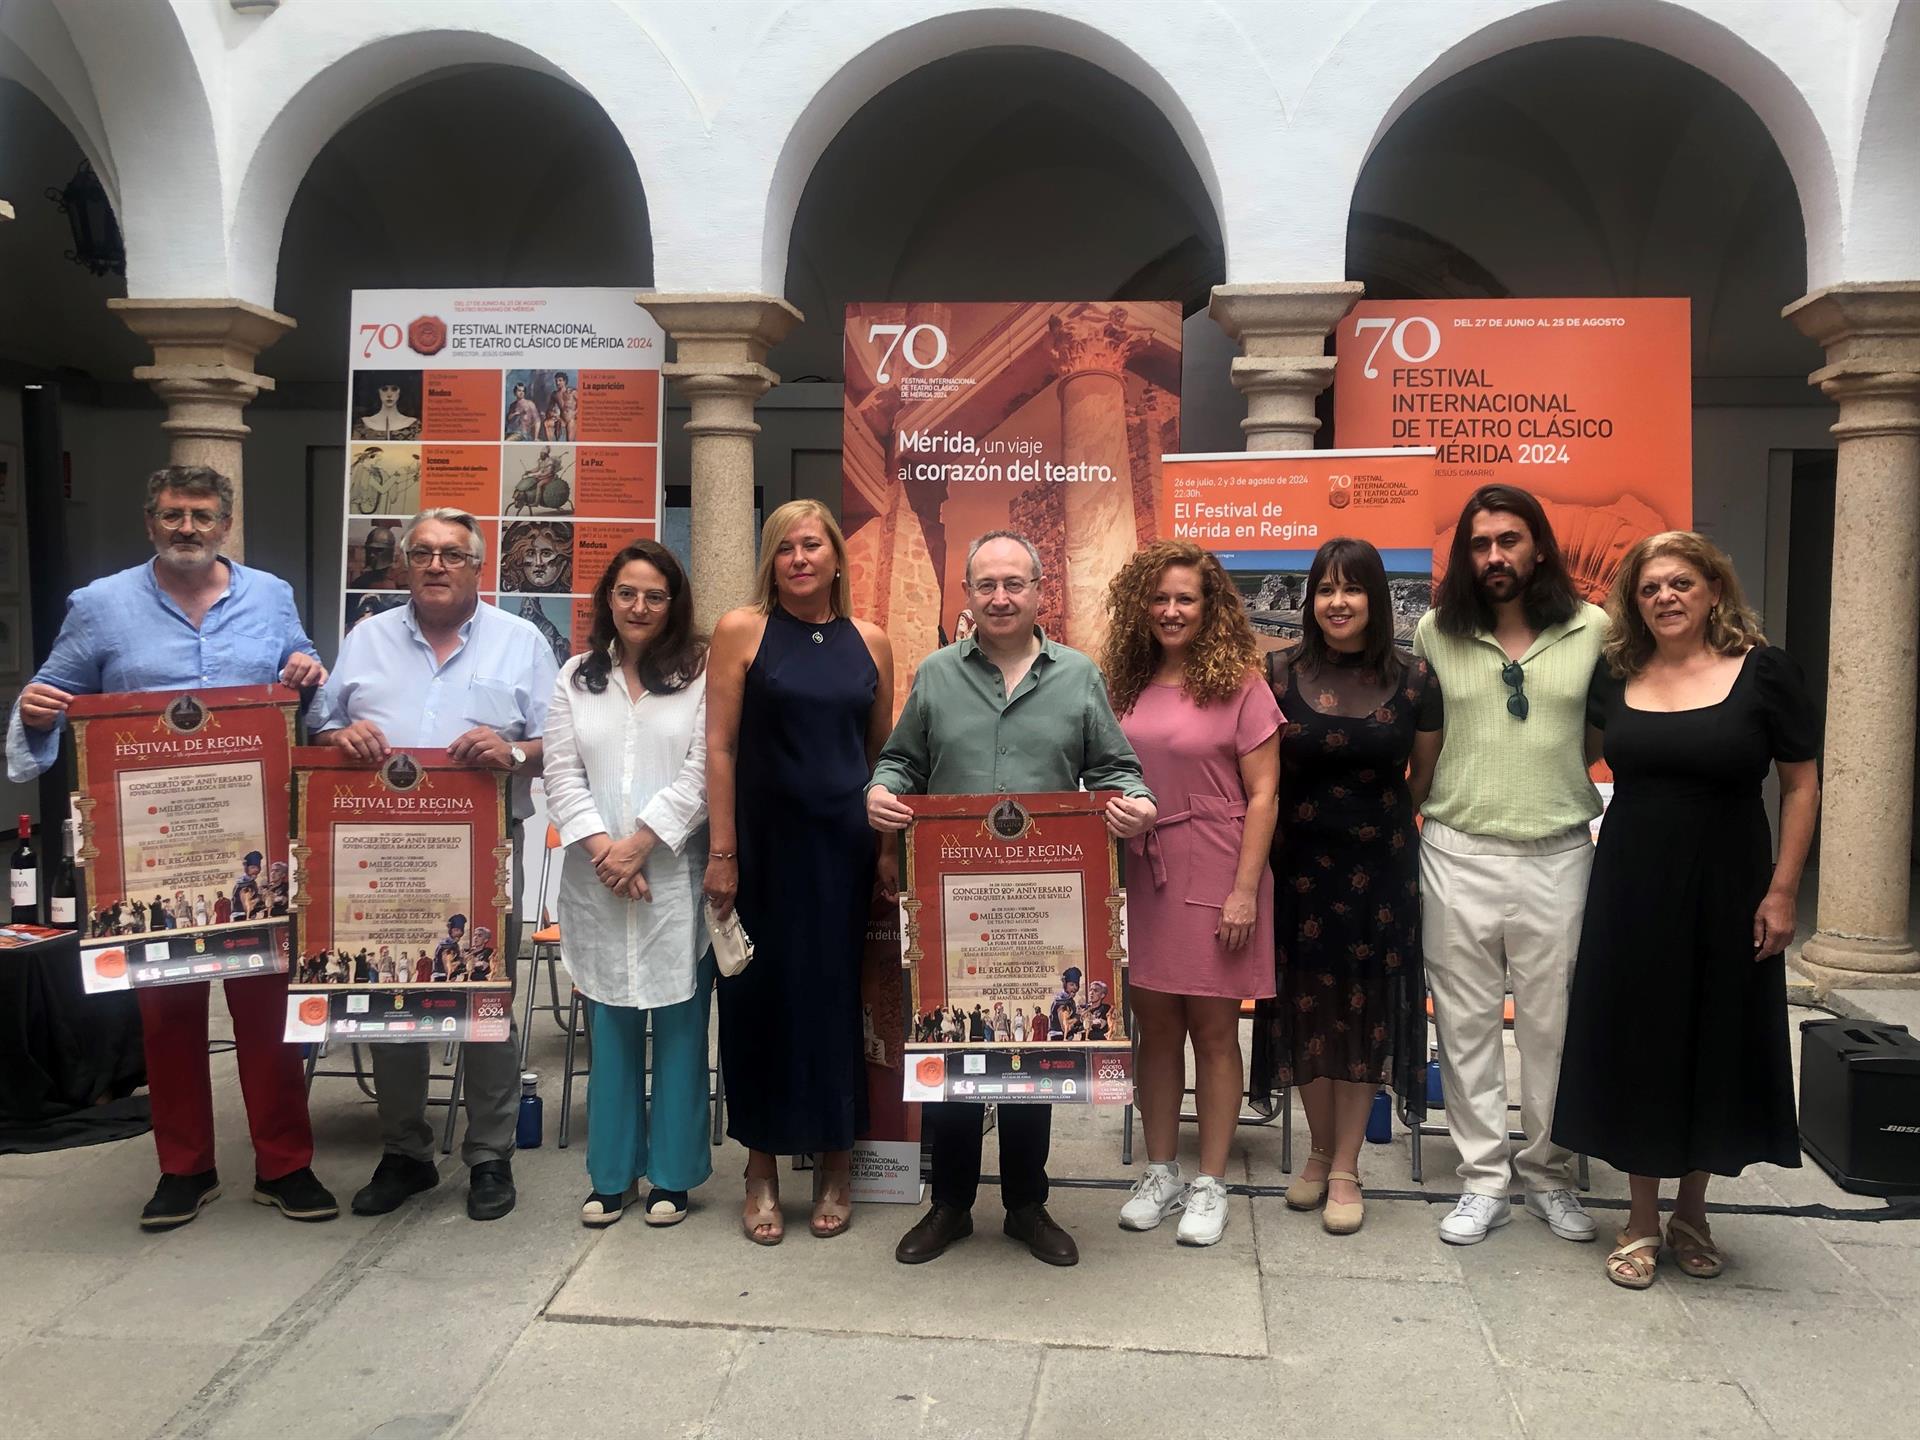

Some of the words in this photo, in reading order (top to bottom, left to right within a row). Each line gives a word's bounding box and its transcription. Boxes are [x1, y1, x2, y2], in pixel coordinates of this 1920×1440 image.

[452, 324, 502, 335] FESTIVAL
[505, 323, 596, 335] INTERNACIONAL
[1454, 319, 1472, 327] DEL
[1475, 319, 1487, 327] 27
[1489, 319, 1502, 327] DE
[1504, 319, 1535, 327] JUNIO
[1582, 318, 1625, 326] AGOSTO
[359, 324, 403, 358] 70
[452, 338, 466, 348] DE
[470, 338, 511, 348] TEATRO
[513, 335, 562, 348] CLÁSICO
[564, 337, 578, 348] DE
[581, 334, 624, 348] MÉRIDA
[627, 337, 652, 348] 2024
[1355, 316, 1441, 379] 70
[868, 324, 947, 384] 70
[1393, 369, 1493, 387] FESTIVAL
[592, 382, 625, 391] aparición
[911, 390, 932, 398] MÉRIDA
[1393, 394, 1576, 412] INTERNACIONAL
[1393, 419, 1421, 438] DE
[1426, 419, 1512, 438] TEATRO
[1517, 414, 1613, 438] CLÁSICO
[899, 430, 981, 457] Mérida,
[985, 441, 1006, 453] un
[1007, 438, 1043, 458] viaje
[1518, 444, 1570, 464] 2024
[591, 459, 604, 467] Paz
[898, 463, 913, 480] al
[916, 460, 1001, 481] corazón
[1007, 461, 1042, 481] del
[1044, 461, 1117, 481] teatro.
[1174, 478, 1183, 487] 26
[1185, 478, 1195, 486] de
[1196, 477, 1216, 488] julio,
[1218, 477, 1222, 486] 2
[1230, 477, 1235, 485] 3
[1236, 477, 1246, 486] de
[1248, 478, 1276, 488] agosto
[1277, 476, 1287, 485] de
[1289, 475, 1308, 484] 2024
[1328, 475, 1351, 492] 70
[1390, 488, 1418, 496] CLÁSICO
[1364, 496, 1389, 504] MÉRIDA
[1174, 503, 1190, 518] El
[1195, 502, 1258, 518] Festival
[1262, 502, 1282, 517] de
[1174, 522, 1230, 538] Mérida
[1236, 526, 1255, 537] en
[1260, 522, 1318, 541] Regina
[115, 731, 138, 744] XX
[116, 741, 179, 756] FESTIVAL
[185, 739, 202, 751] DE
[207, 735, 262, 749] REGINA
[129, 780, 179, 791] CONCIERTO
[196, 774, 252, 785] ANIVERSARIO
[334, 785, 354, 797] XX
[159, 804, 182, 813] MILES
[184, 800, 229, 811] GLORIOSUS
[333, 797, 393, 808] FESTIVAL
[397, 798, 415, 808] DE
[420, 797, 474, 808] REGINA
[187, 822, 219, 831] TITANES
[940, 834, 961, 847] XX
[217, 851, 236, 859] ZEUS
[941, 847, 1001, 859] FESTIVAL
[1006, 846, 1024, 857] DE
[1028, 844, 1083, 857] REGINA
[1017, 886, 1072, 894] ANIVERSARIO
[1005, 911, 1049, 919] GLORIOSUS
[875, 930, 891, 940] del
[478, 1007, 504, 1016] 2024
[1098, 1069, 1125, 1078] 2024
[1880, 1125, 1920, 1134] BOSE
